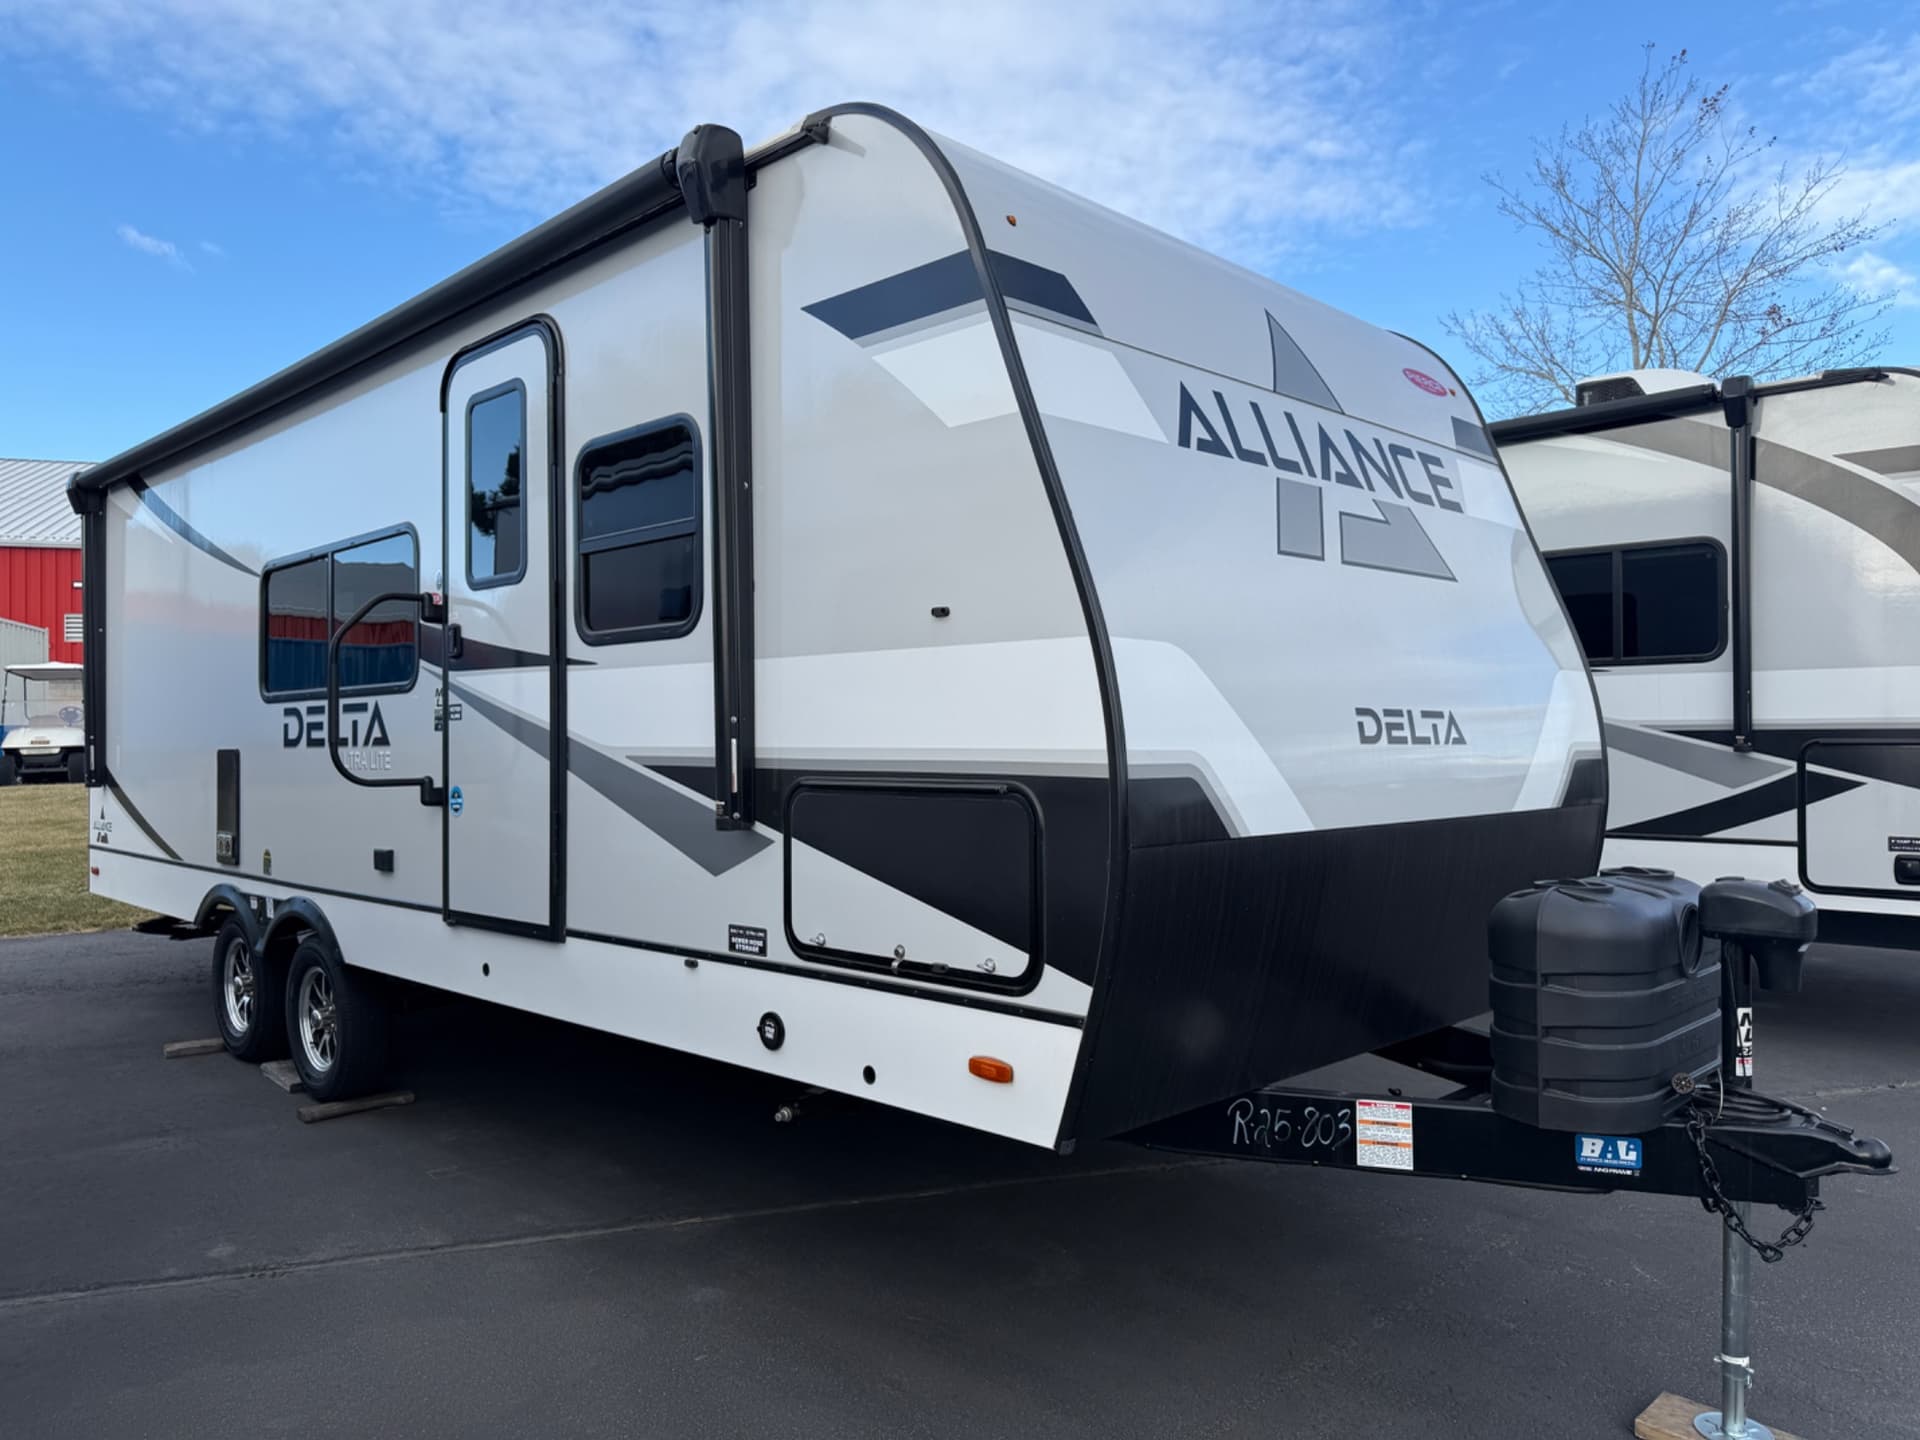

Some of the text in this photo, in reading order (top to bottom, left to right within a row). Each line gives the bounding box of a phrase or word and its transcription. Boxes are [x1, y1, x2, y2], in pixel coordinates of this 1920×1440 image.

[1178, 381, 1464, 513] ALLIANCE
[1355, 707, 1467, 745] DELTA
[1581, 1137, 1638, 1161] BAL
